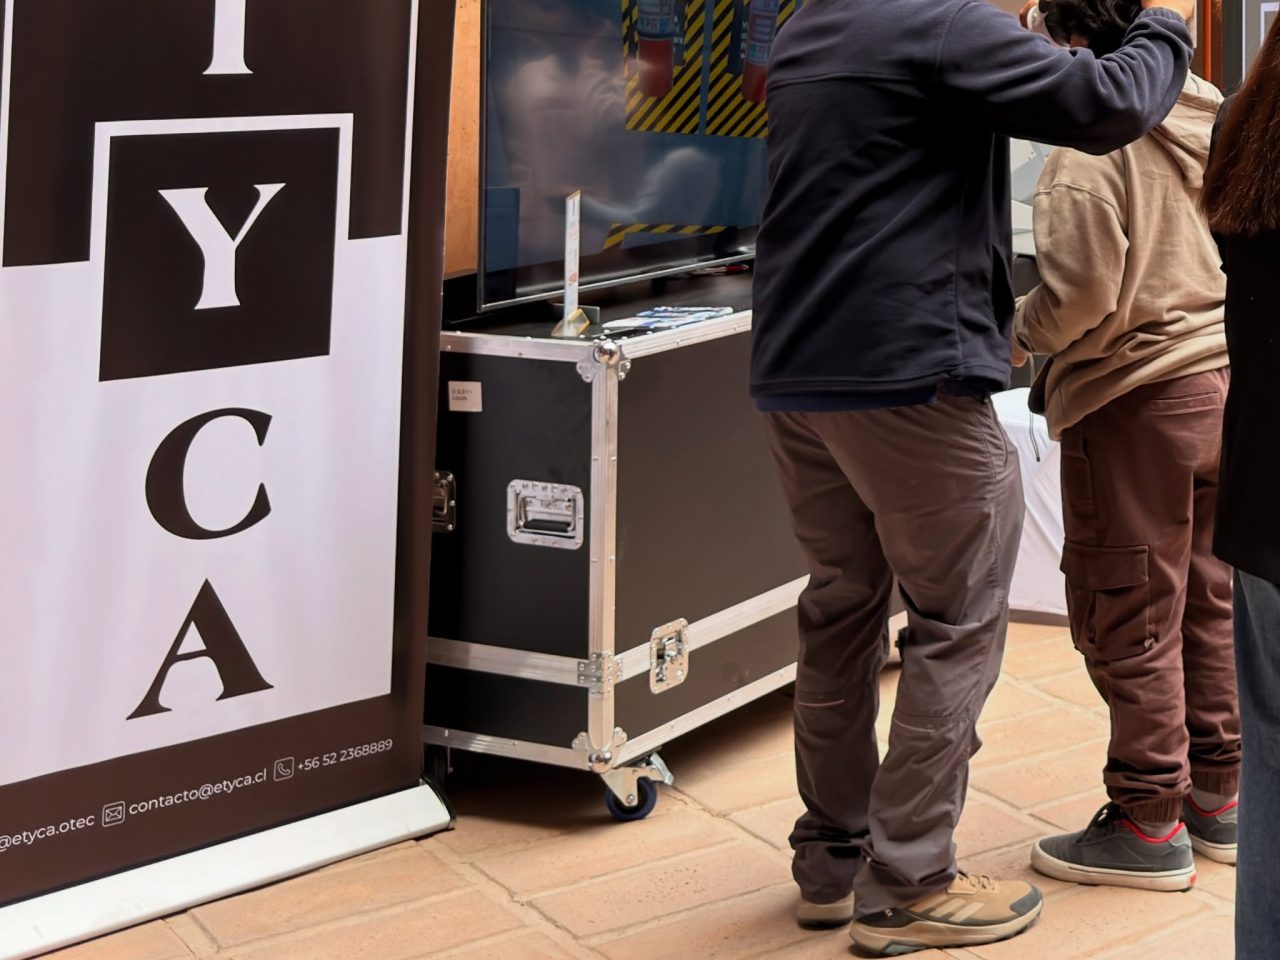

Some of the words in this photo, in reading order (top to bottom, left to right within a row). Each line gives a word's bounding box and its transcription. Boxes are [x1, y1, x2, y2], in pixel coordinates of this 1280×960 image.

[128, 768, 267, 816] contacto@etyca.cl
[297, 757, 320, 771] +56
[322, 752, 338, 766] 52
[340, 738, 393, 762] 2368889
